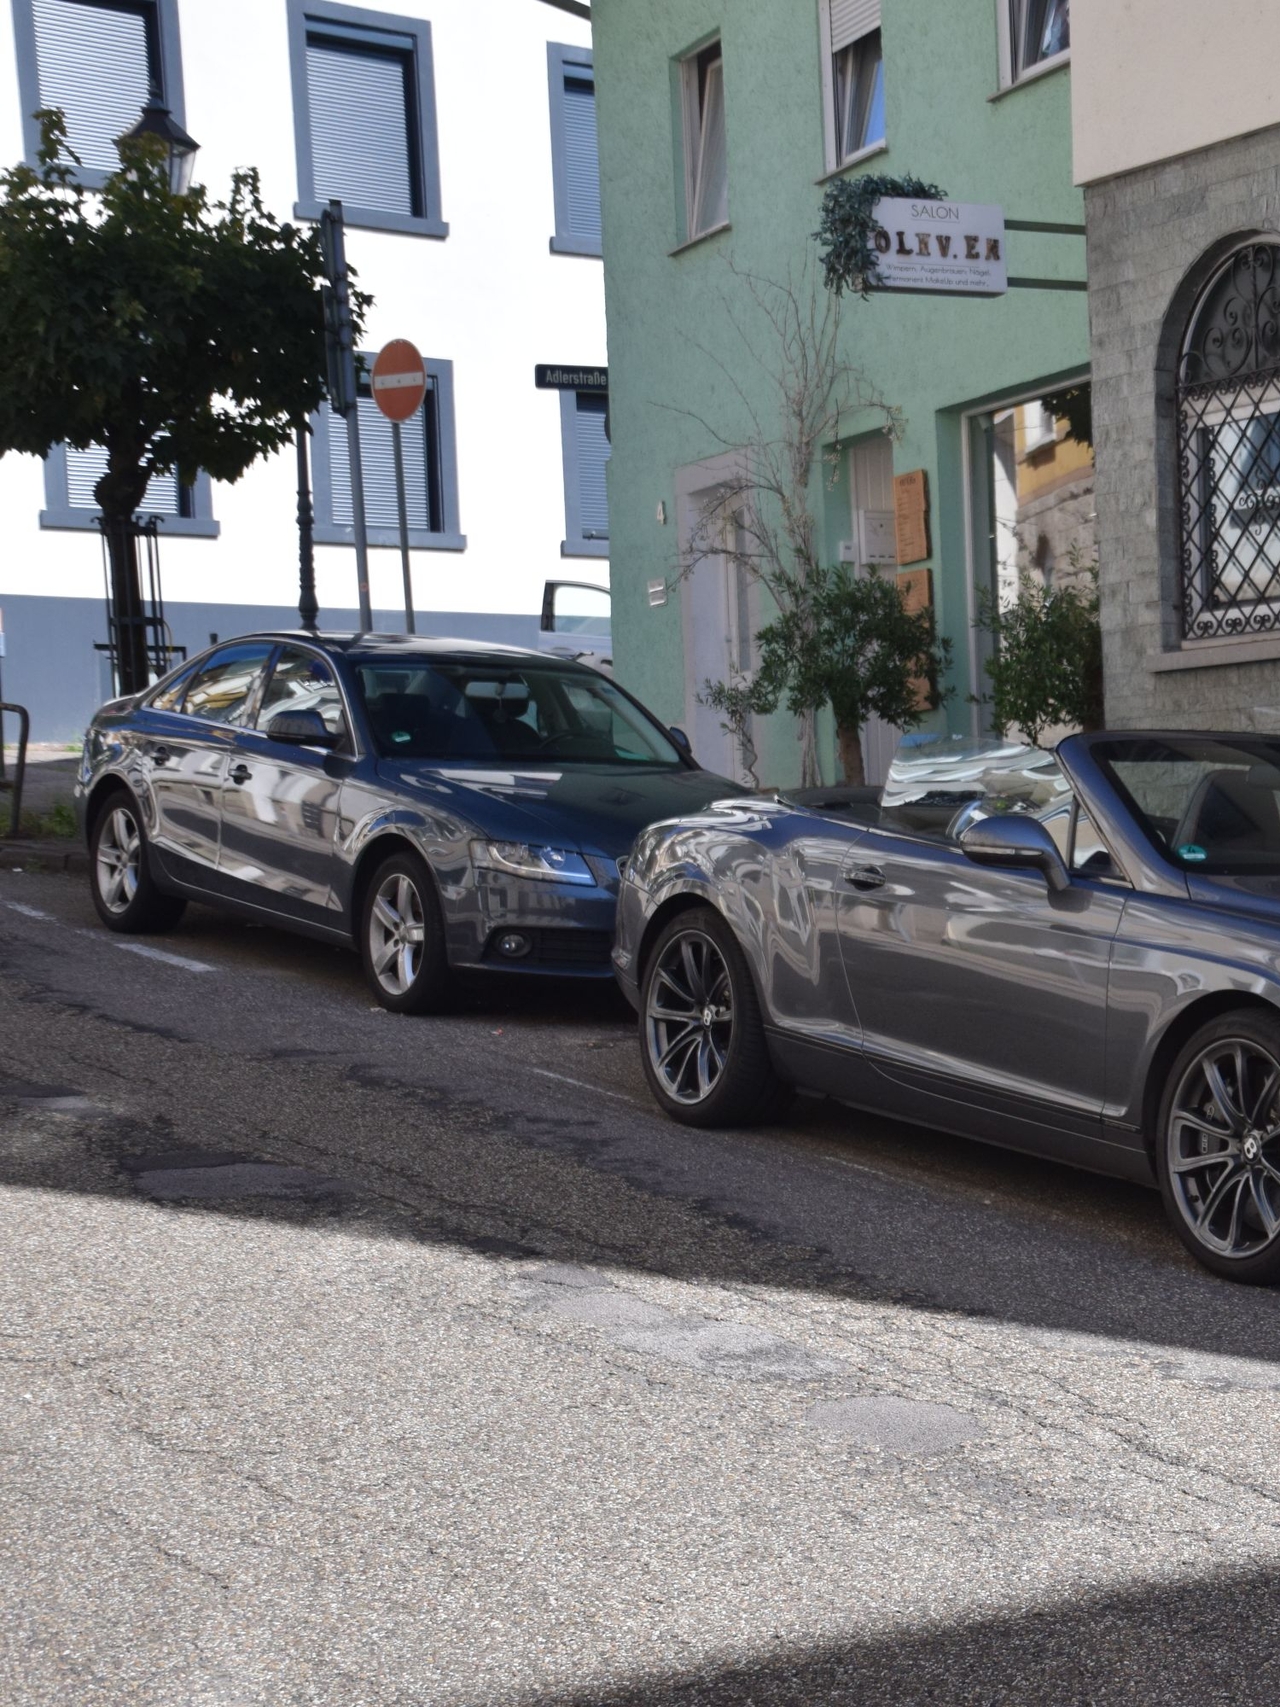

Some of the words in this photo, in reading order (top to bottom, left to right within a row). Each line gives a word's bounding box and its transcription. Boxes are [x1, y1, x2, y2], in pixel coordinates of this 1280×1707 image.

[911, 204, 959, 219] SALON
[545, 368, 607, 386] Adlerstraße
[656, 500, 665, 525] 4
